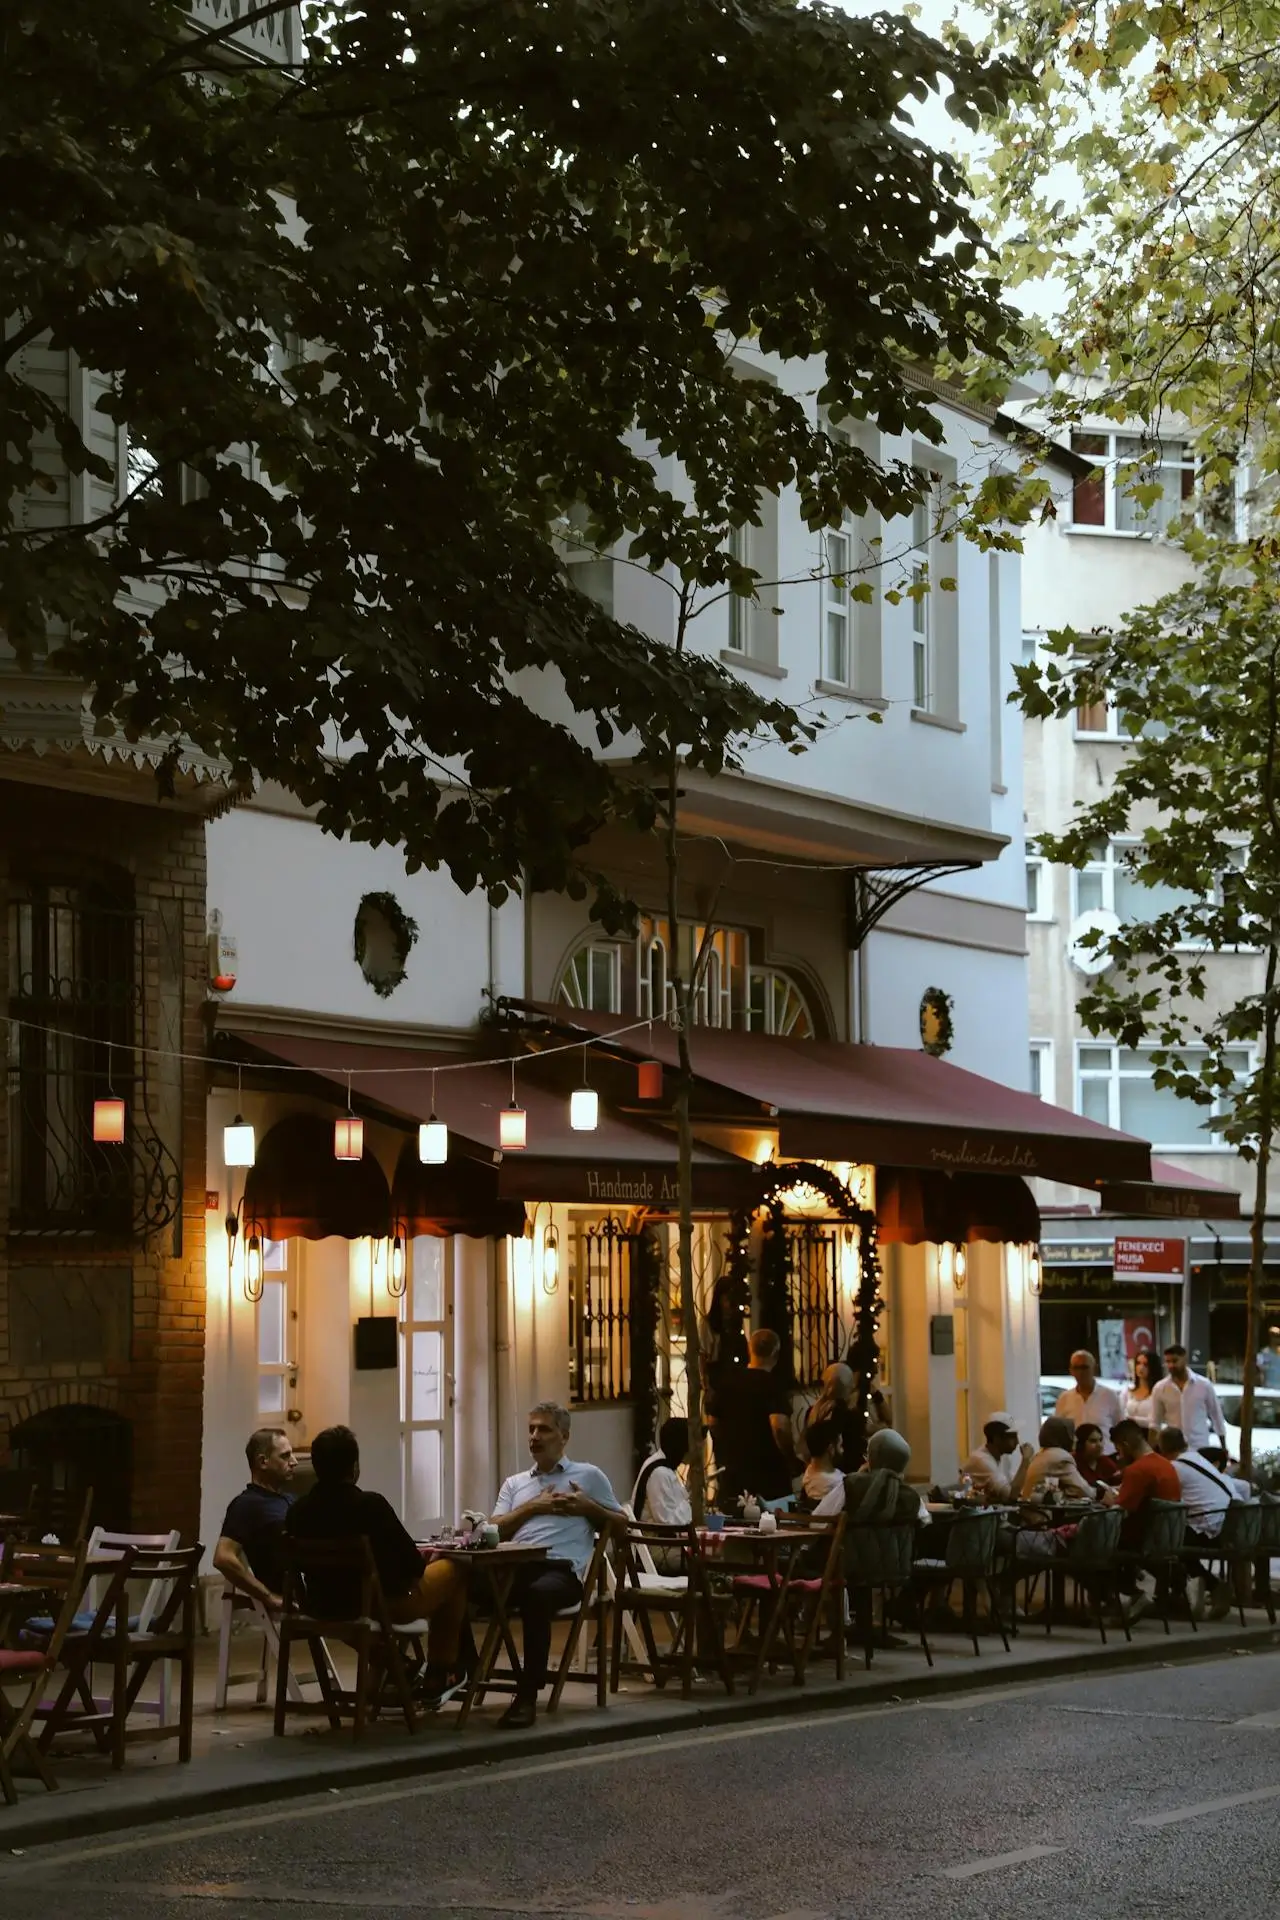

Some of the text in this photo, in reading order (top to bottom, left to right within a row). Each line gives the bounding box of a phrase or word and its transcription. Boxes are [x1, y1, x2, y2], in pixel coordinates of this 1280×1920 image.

[586, 1170, 653, 1200] Handmade
[1117, 1241, 1165, 1253] TENEKECİ
[1116, 1253, 1145, 1265] MUSA
